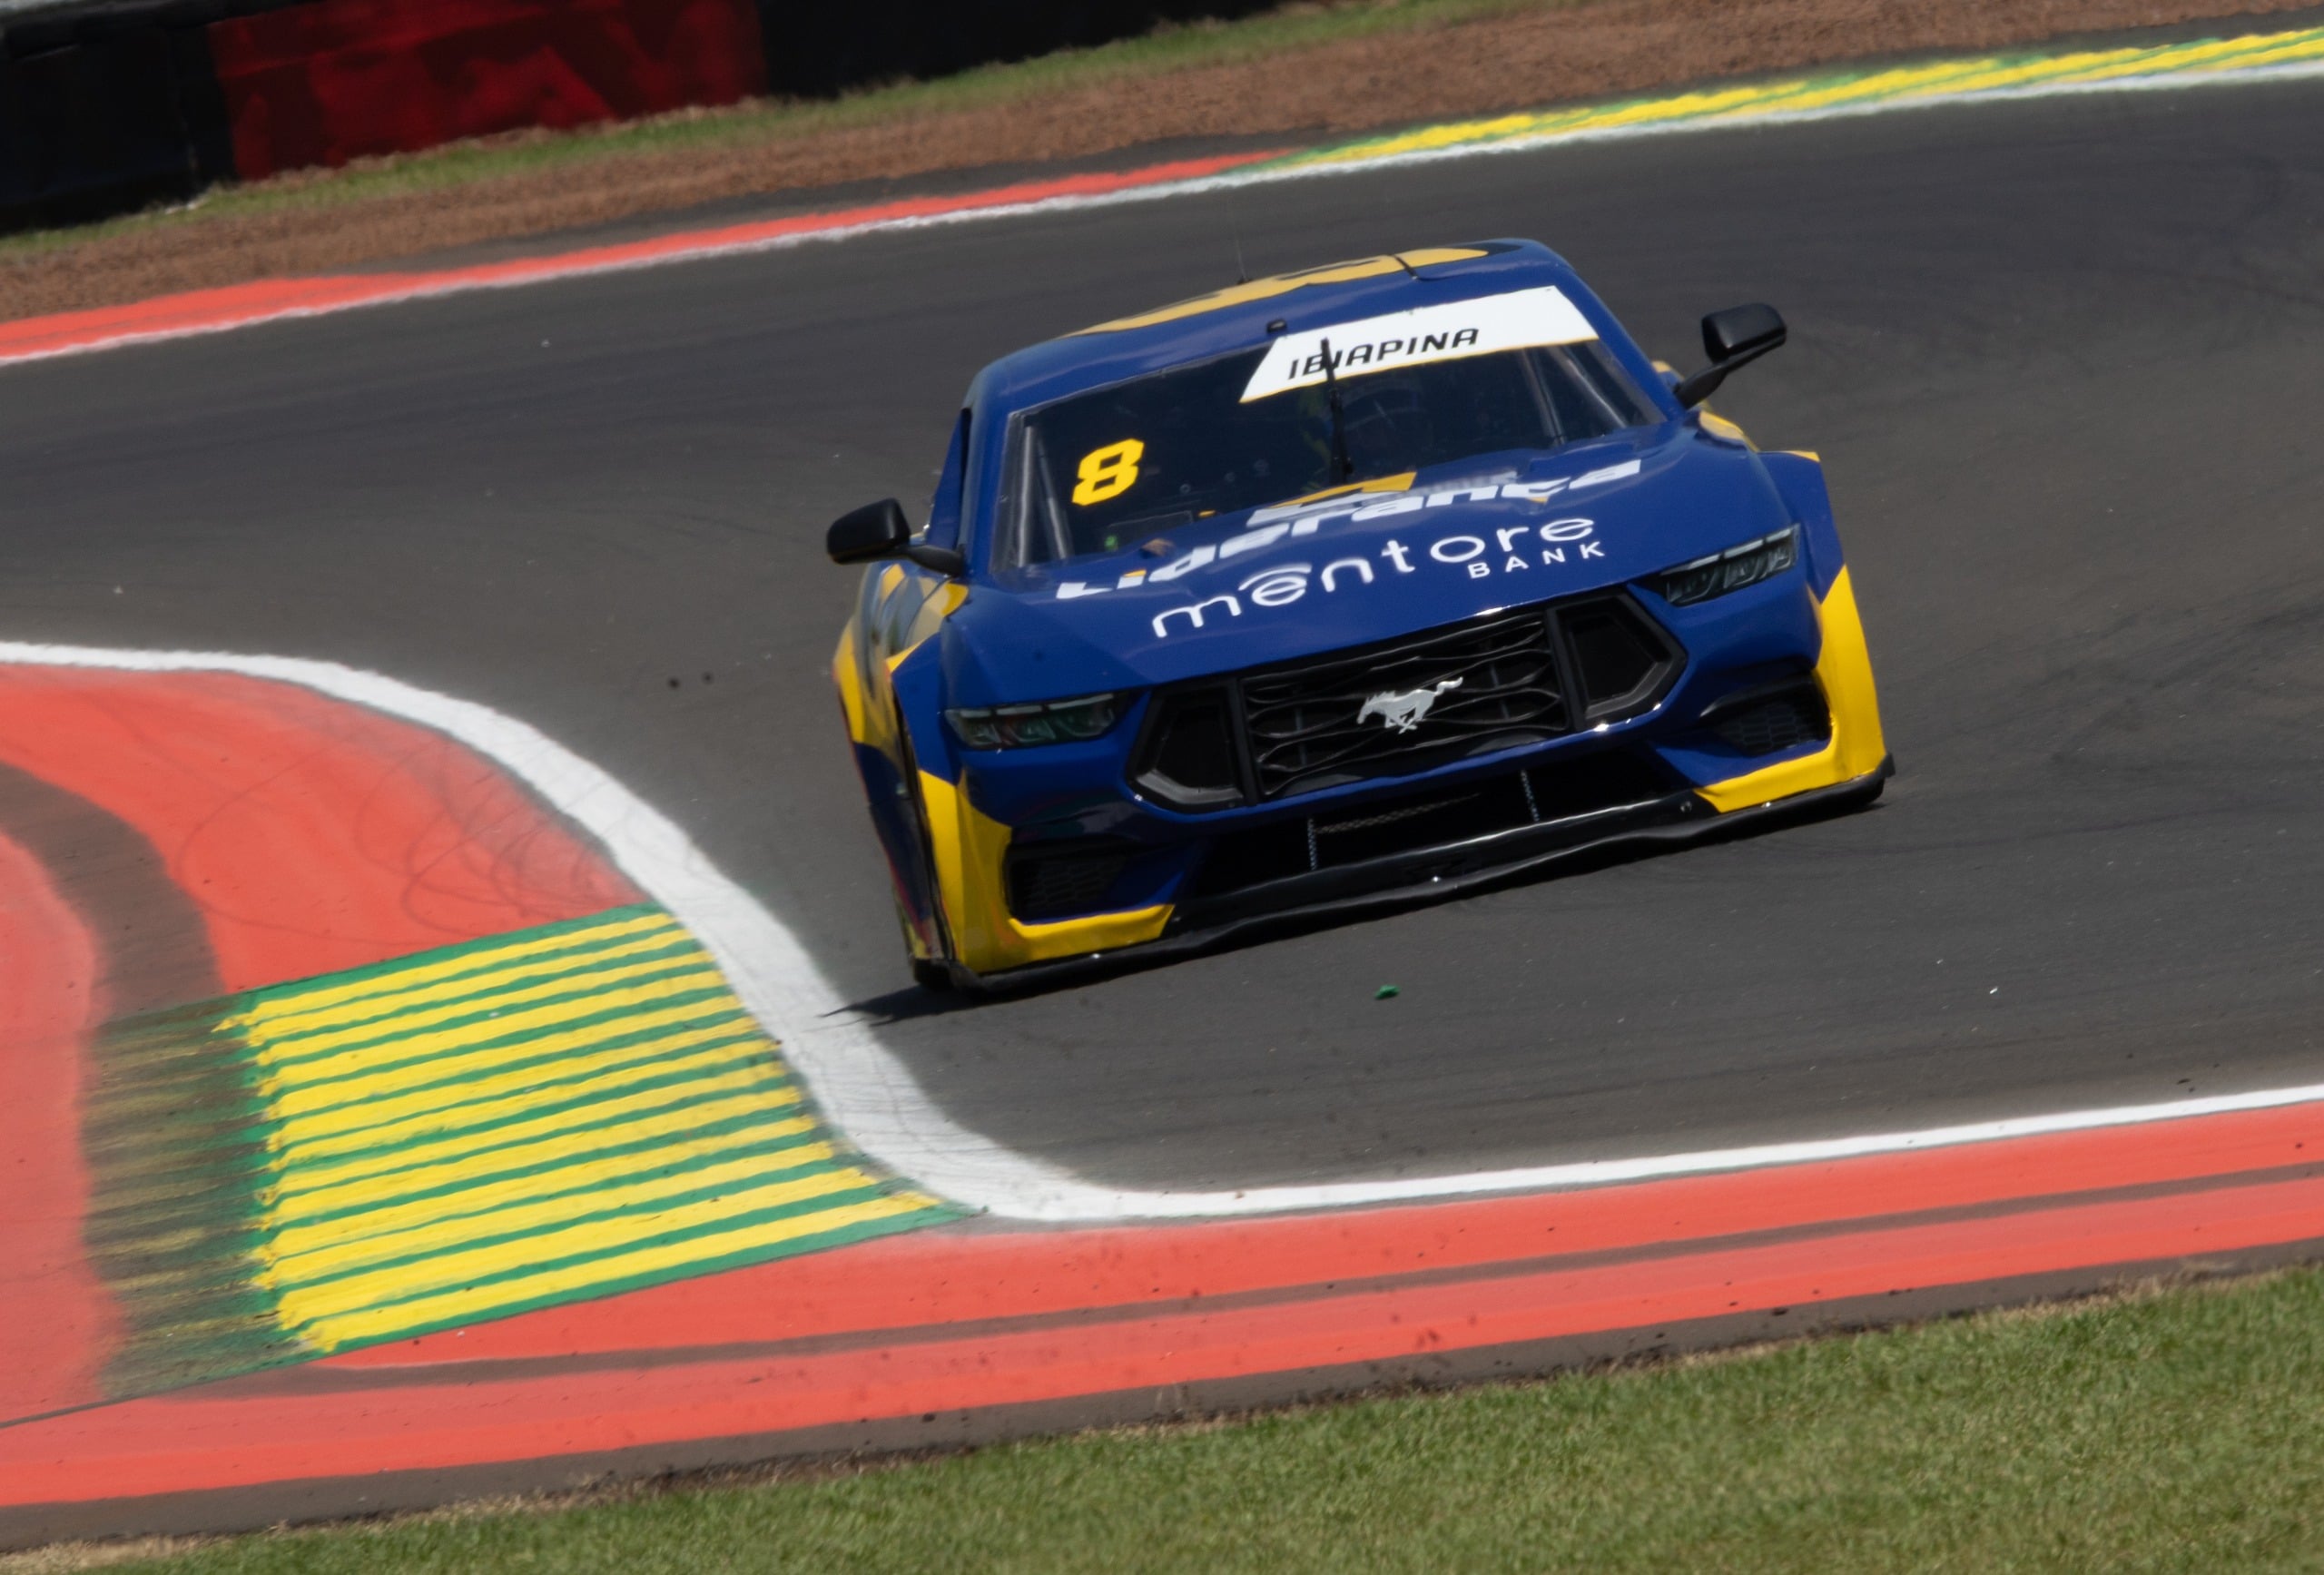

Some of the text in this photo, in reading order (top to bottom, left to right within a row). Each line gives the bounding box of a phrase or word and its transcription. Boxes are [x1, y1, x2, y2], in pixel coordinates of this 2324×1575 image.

[1287, 328, 1480, 380] IBIAPINA
[1071, 438, 1145, 507] 8
[1151, 517, 1595, 639] mentore
[1466, 538, 1605, 579] BANK
